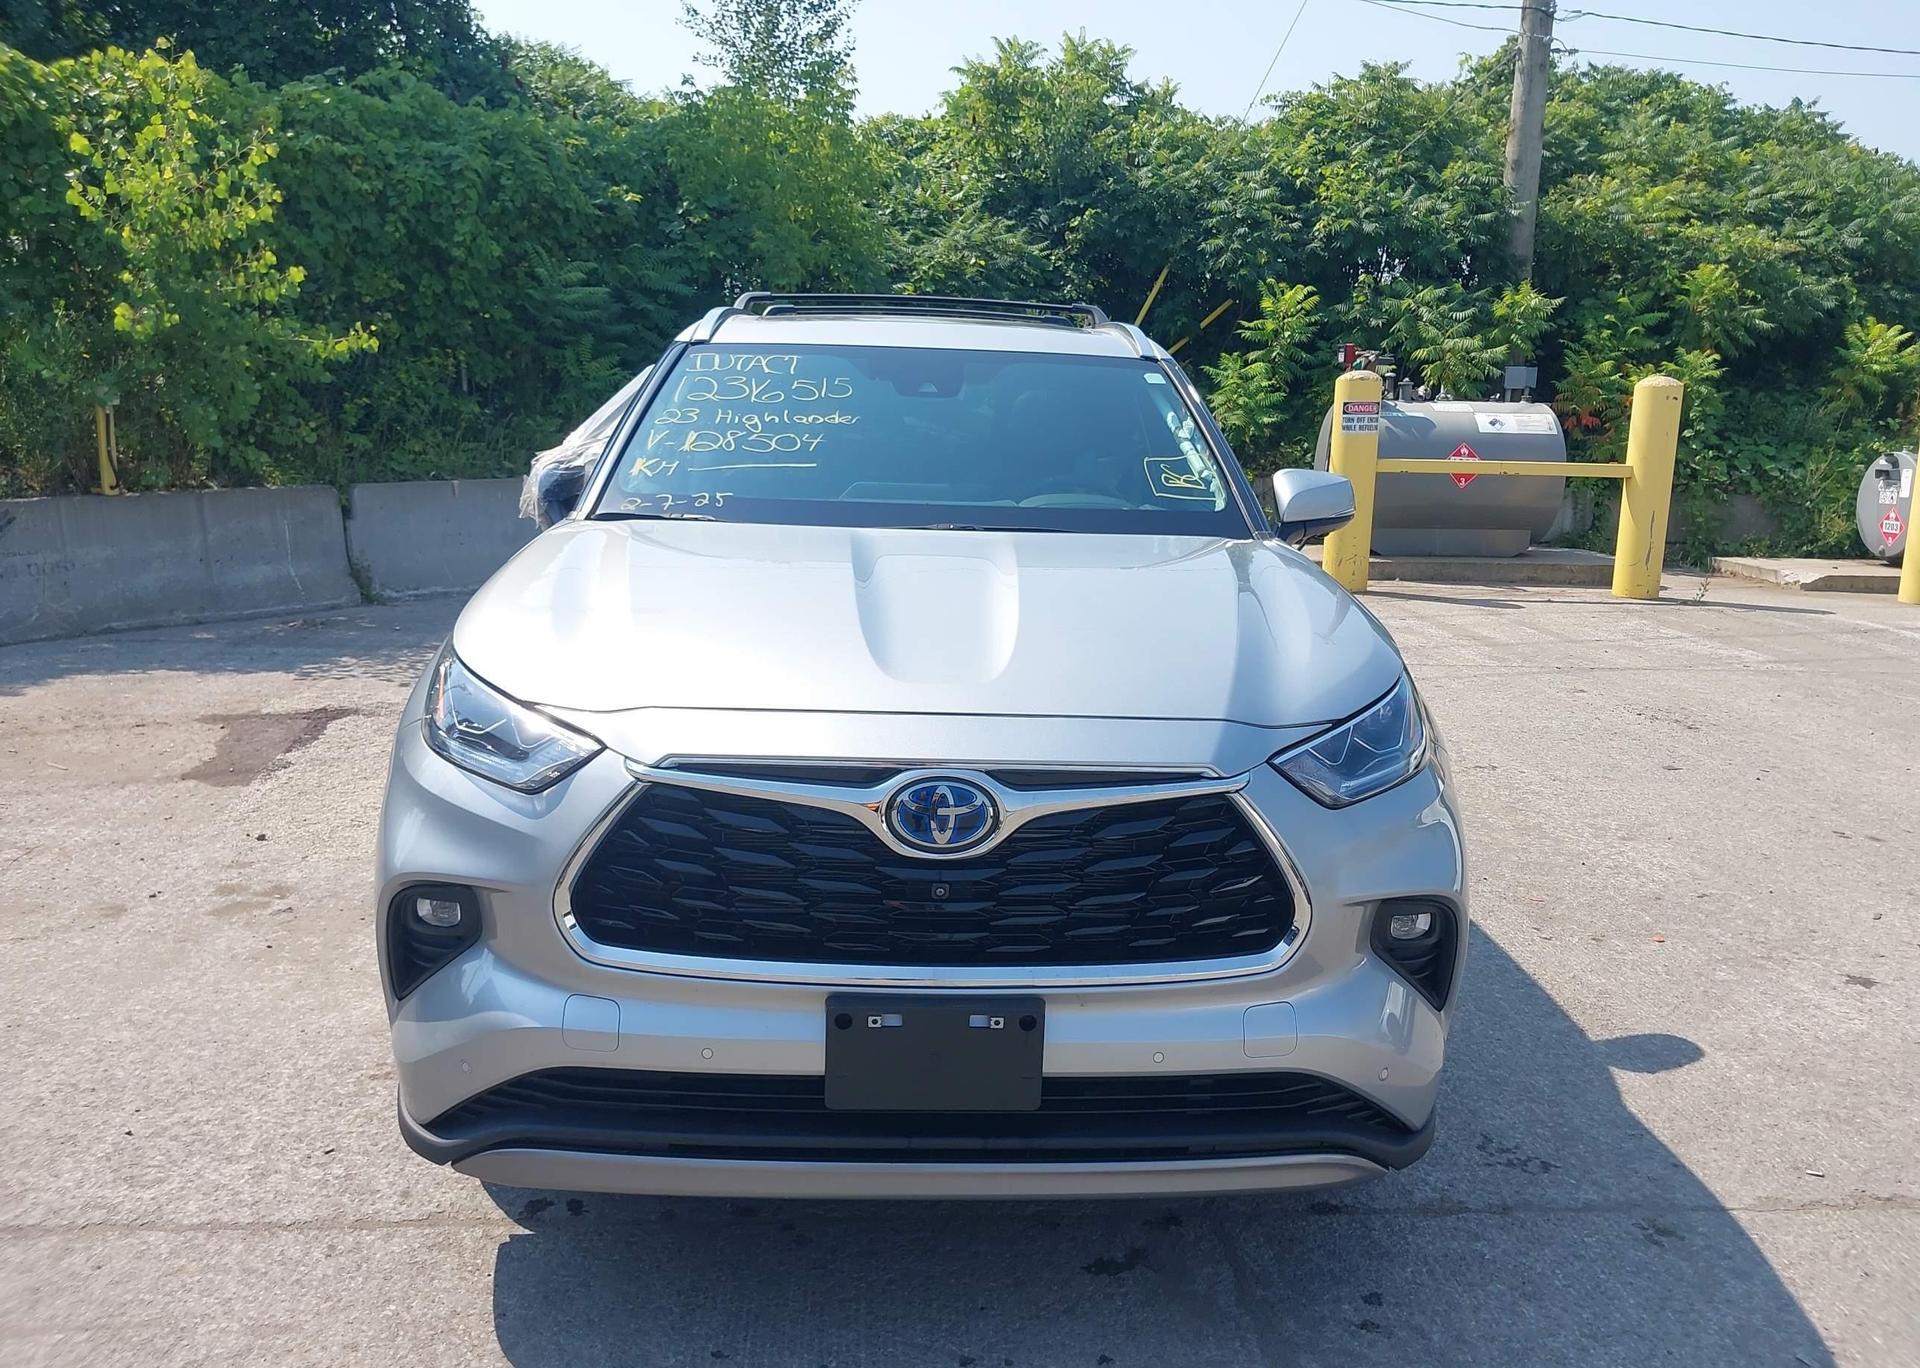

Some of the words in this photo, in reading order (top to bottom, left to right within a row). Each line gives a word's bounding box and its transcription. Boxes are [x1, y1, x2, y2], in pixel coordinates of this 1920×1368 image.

[1348, 404, 1376, 412] DANGER
[655, 408, 701, 424] 23
[715, 409, 861, 433] Highlander
[1459, 477, 1466, 486] 3
[1884, 522, 1899, 531] 1203
